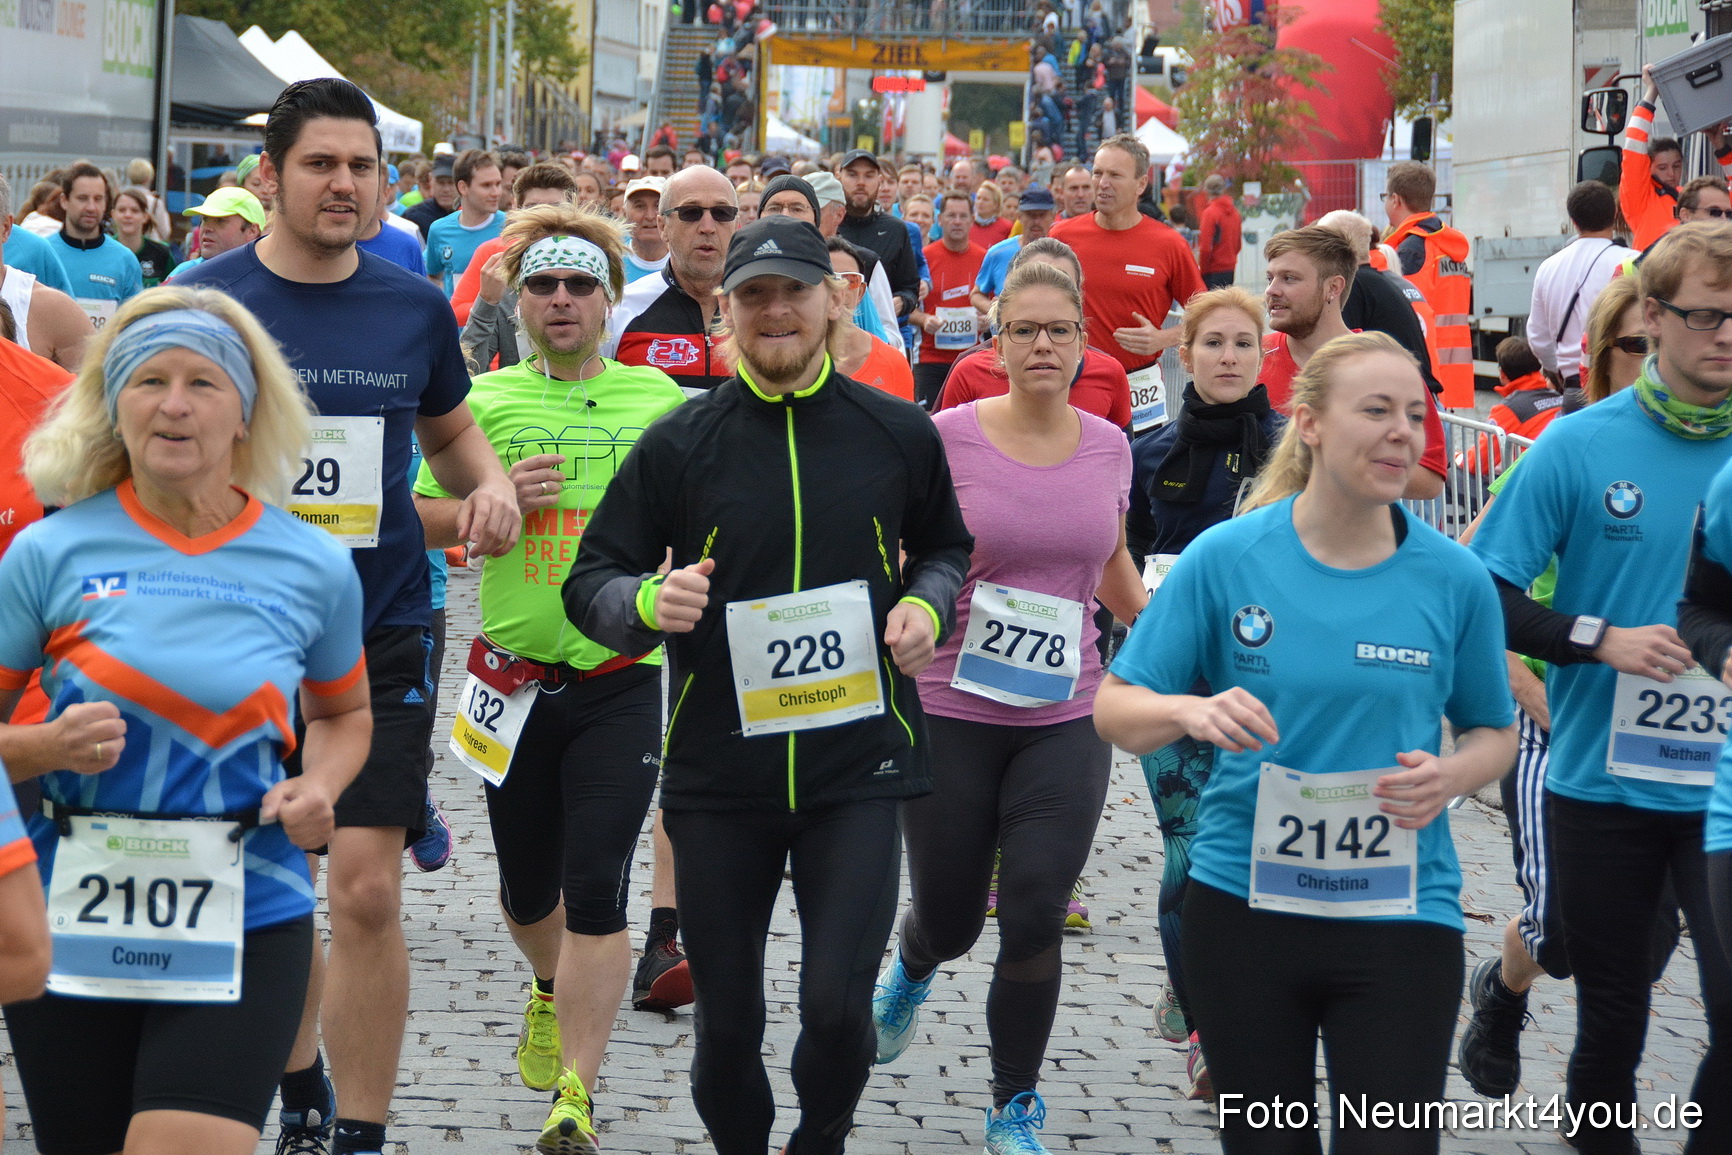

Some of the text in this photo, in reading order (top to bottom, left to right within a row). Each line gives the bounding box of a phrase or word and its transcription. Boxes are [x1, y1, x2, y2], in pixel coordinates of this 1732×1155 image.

[872, 43, 928, 66] ZIEL
[89, 273, 116, 285] BOCK
[942, 320, 972, 334] 2038
[323, 369, 408, 389] METRAWATT
[525, 508, 594, 536] ME
[1604, 525, 1643, 535] PARTL
[525, 539, 582, 562] PRE
[137, 570, 246, 594] Raiffeisenbank
[524, 562, 573, 586] RE
[136, 585, 211, 599] Neumarkt
[782, 601, 831, 620] BOCK
[1018, 601, 1058, 617] BOCK
[767, 630, 845, 679] 228
[980, 619, 1066, 668] 2778
[1356, 643, 1431, 666] BOCK
[1233, 652, 1270, 668] PARTL
[779, 684, 847, 708] Christoph
[468, 683, 505, 733] 132
[463, 728, 488, 755] Andreas
[1659, 744, 1712, 762] Nathan
[1315, 783, 1370, 800] BOCK
[124, 836, 190, 854] BOCK
[1276, 814, 1391, 860] 2142
[1297, 873, 1369, 893] Christina
[76, 873, 214, 929] 2107
[112, 945, 173, 971] Conny
